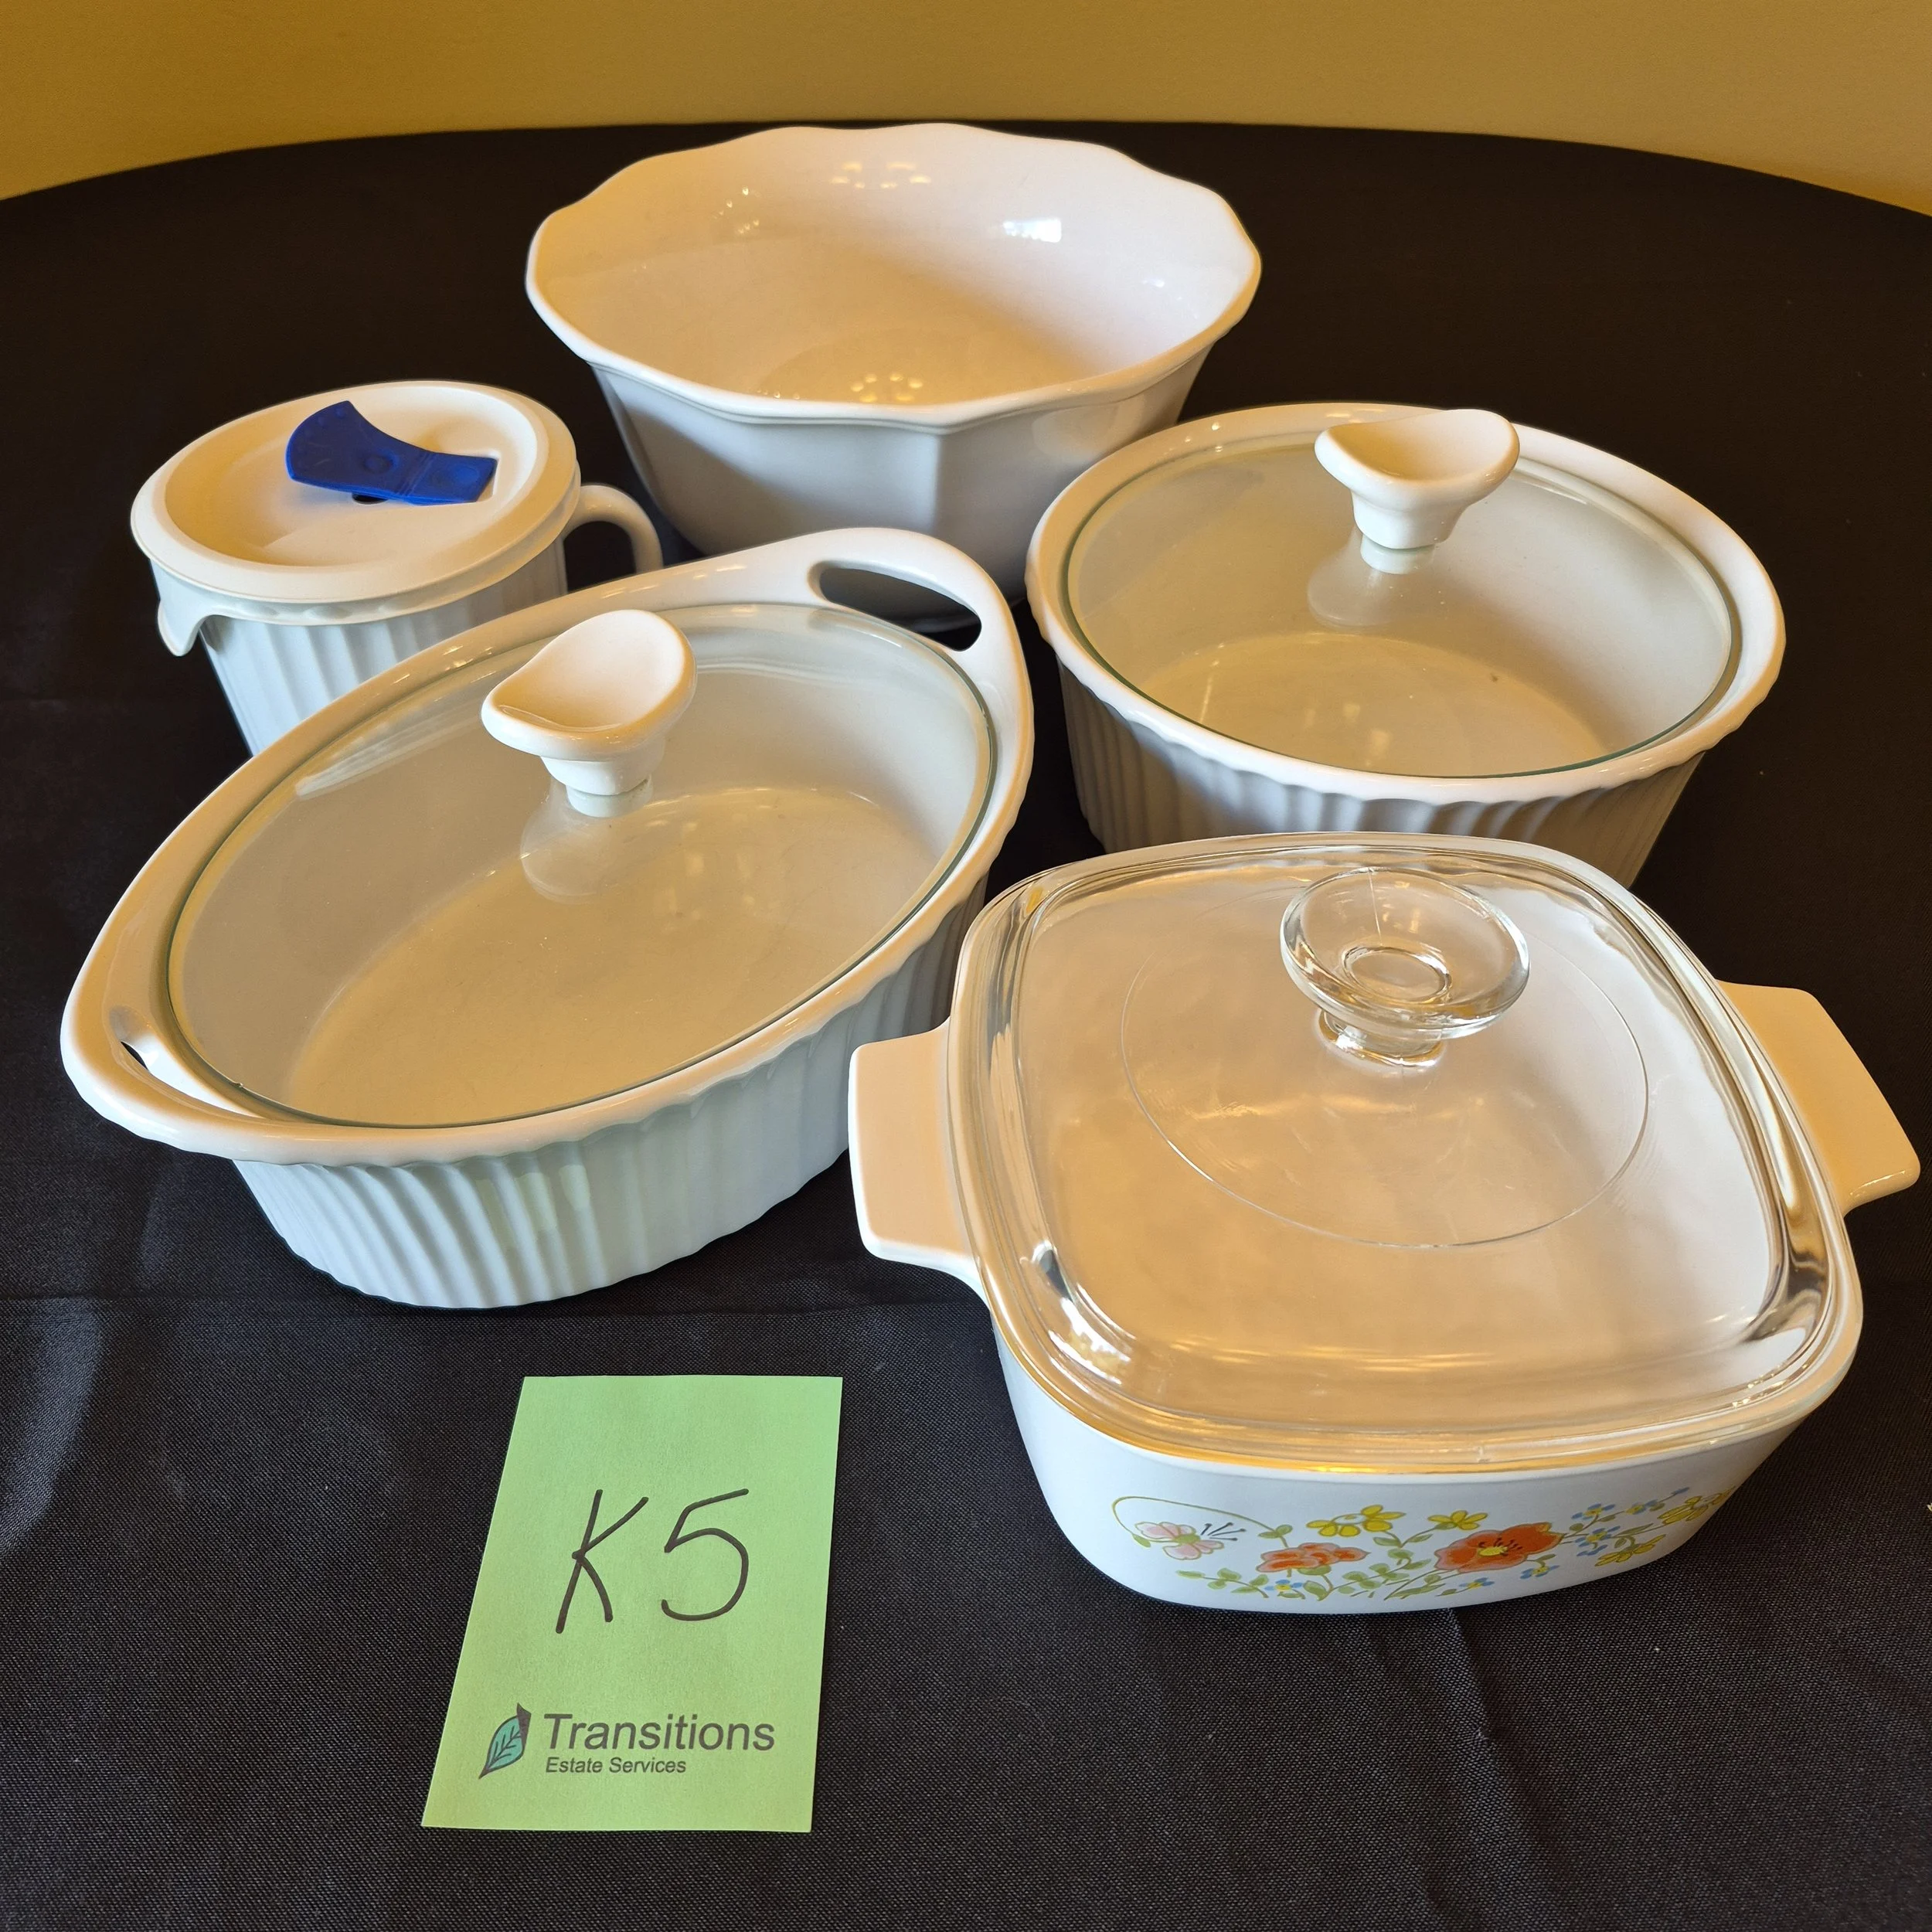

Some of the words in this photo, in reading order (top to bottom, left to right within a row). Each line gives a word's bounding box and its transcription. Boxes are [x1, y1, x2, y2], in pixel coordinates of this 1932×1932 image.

[555, 1488, 750, 1634] K5
[544, 1713, 775, 1751] Transitions
[545, 1757, 604, 1773] Estate
[609, 1756, 686, 1774] Services
